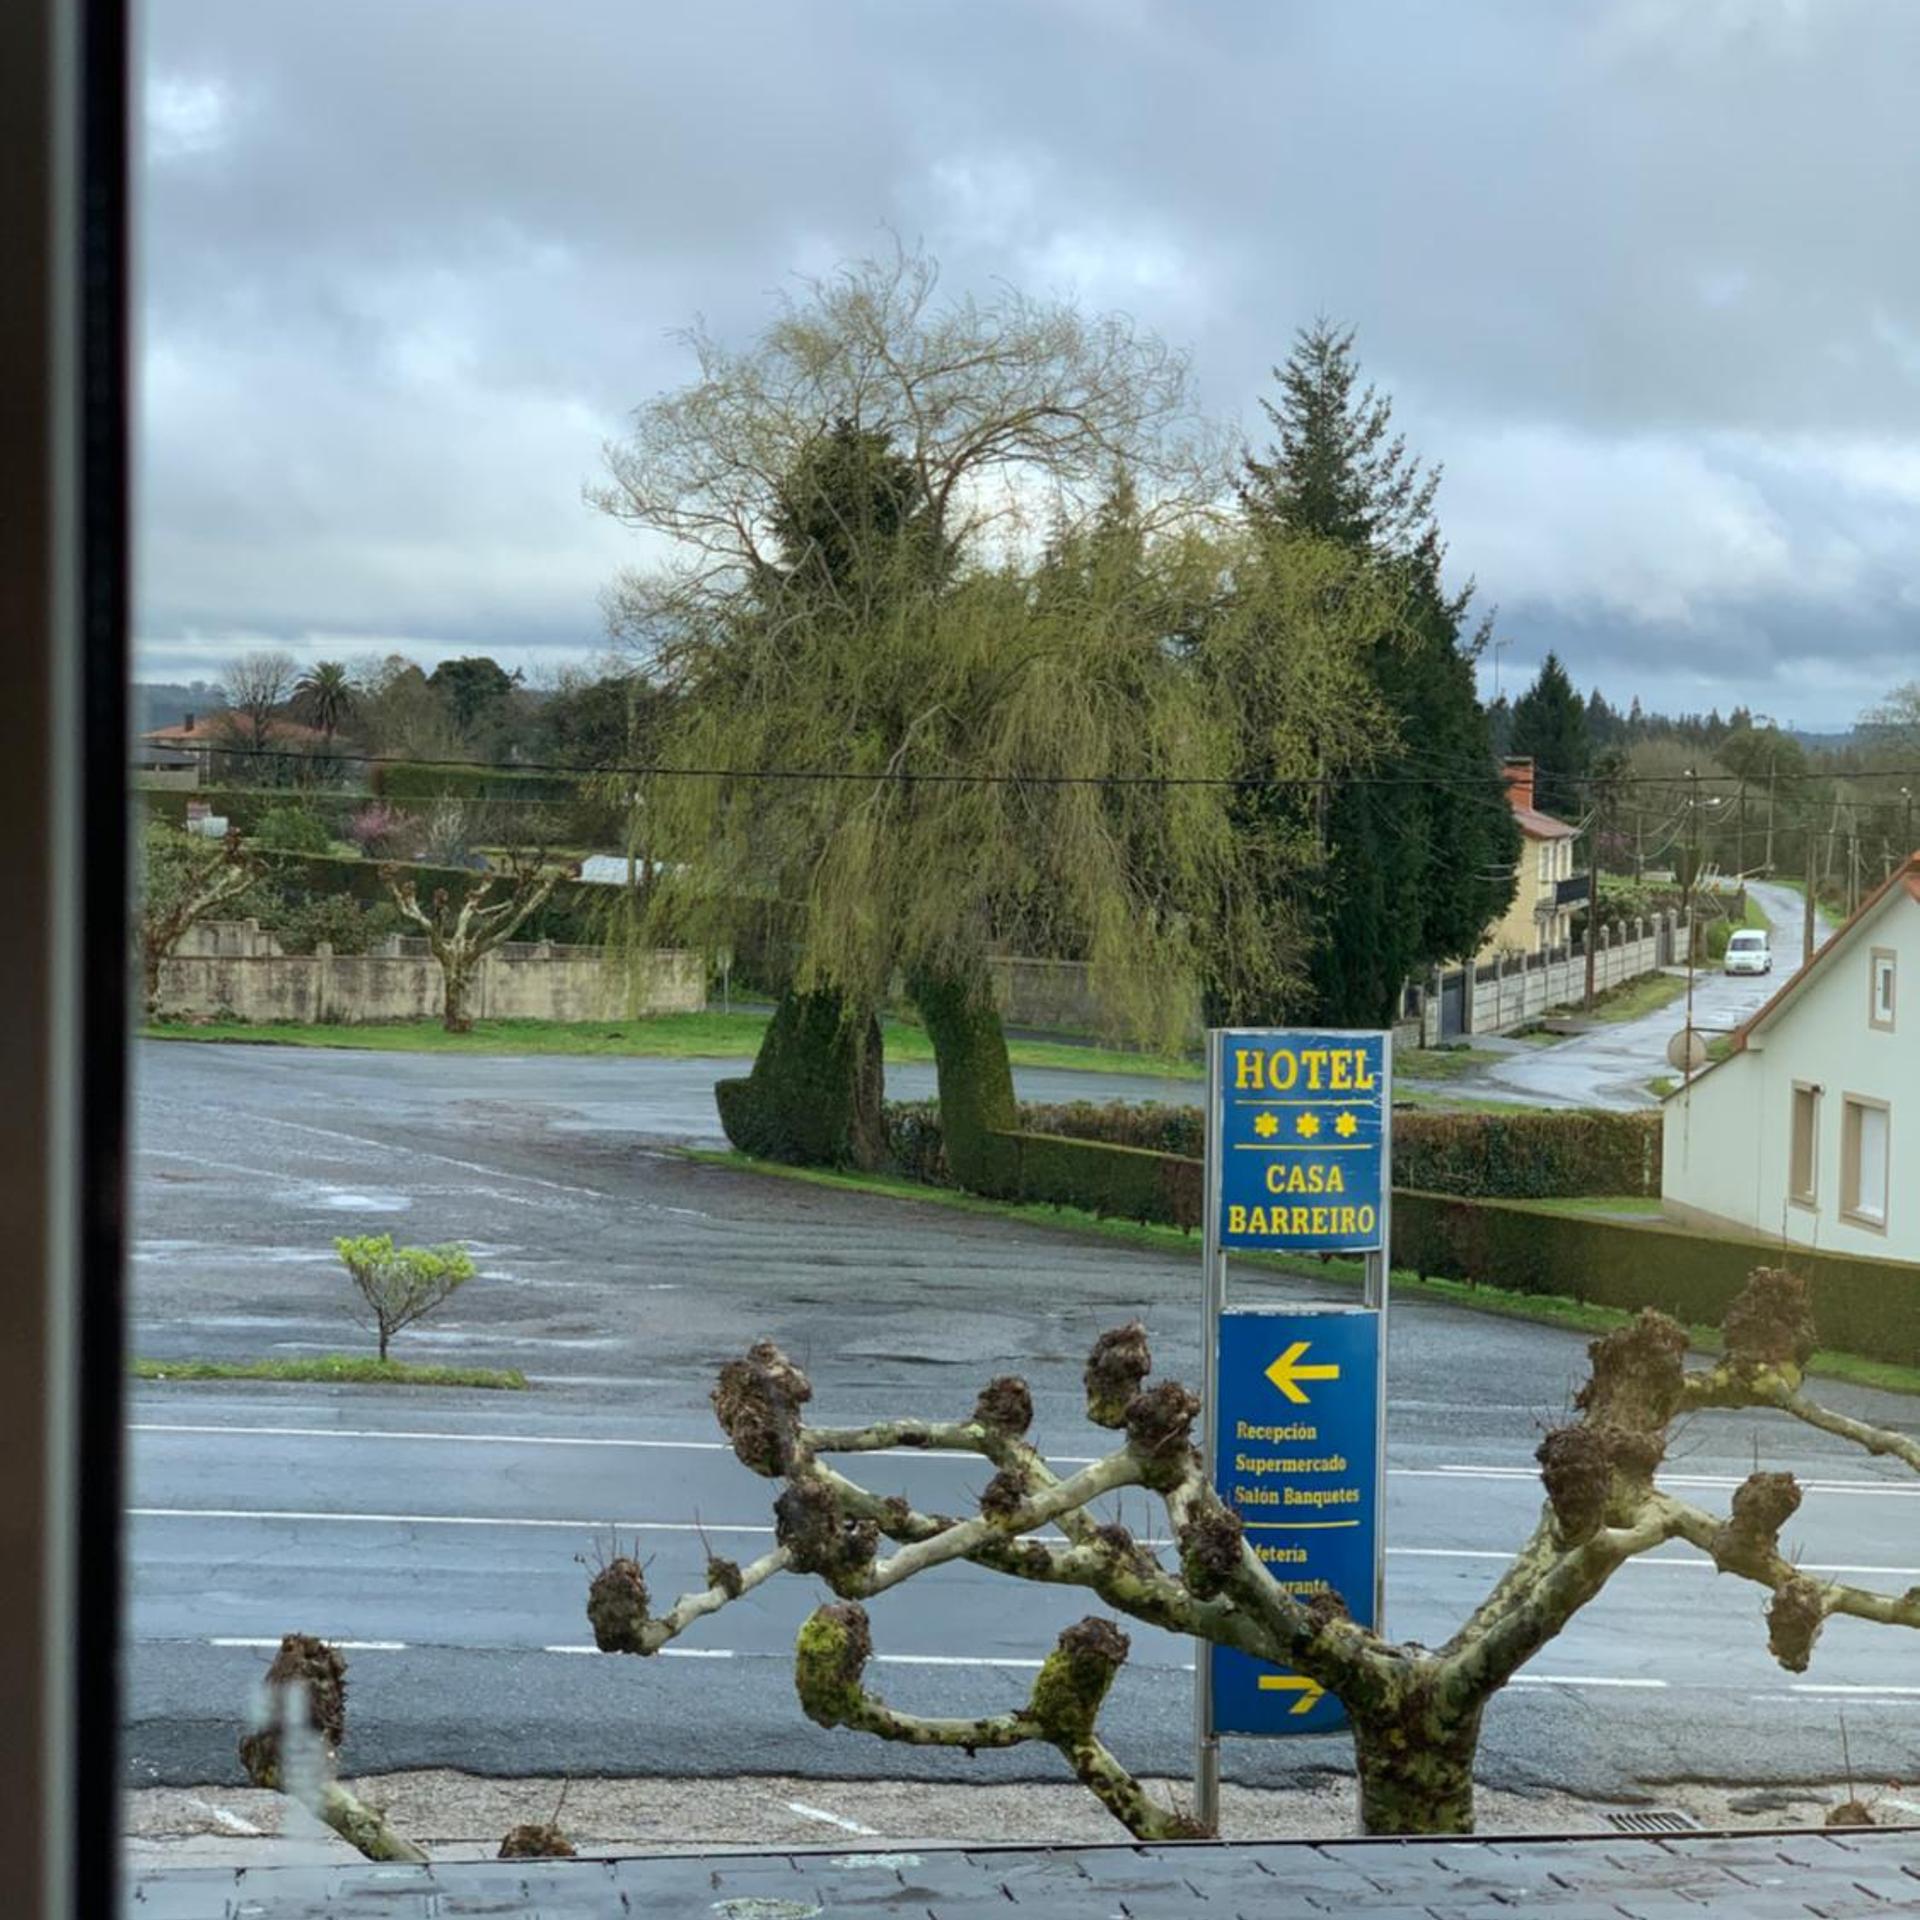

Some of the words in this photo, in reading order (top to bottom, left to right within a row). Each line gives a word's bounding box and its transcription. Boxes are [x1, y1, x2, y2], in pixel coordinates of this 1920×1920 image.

[1235, 1049, 1374, 1090] HOTEL
[1266, 1164, 1345, 1193] CASA
[1228, 1205, 1375, 1234] BARREIRO
[1236, 1420, 1317, 1444] Recepción
[1235, 1453, 1347, 1476] Supermercado
[1235, 1485, 1279, 1505] Salón
[1283, 1487, 1360, 1508] Banquetes
[1255, 1543, 1307, 1563] fetería
